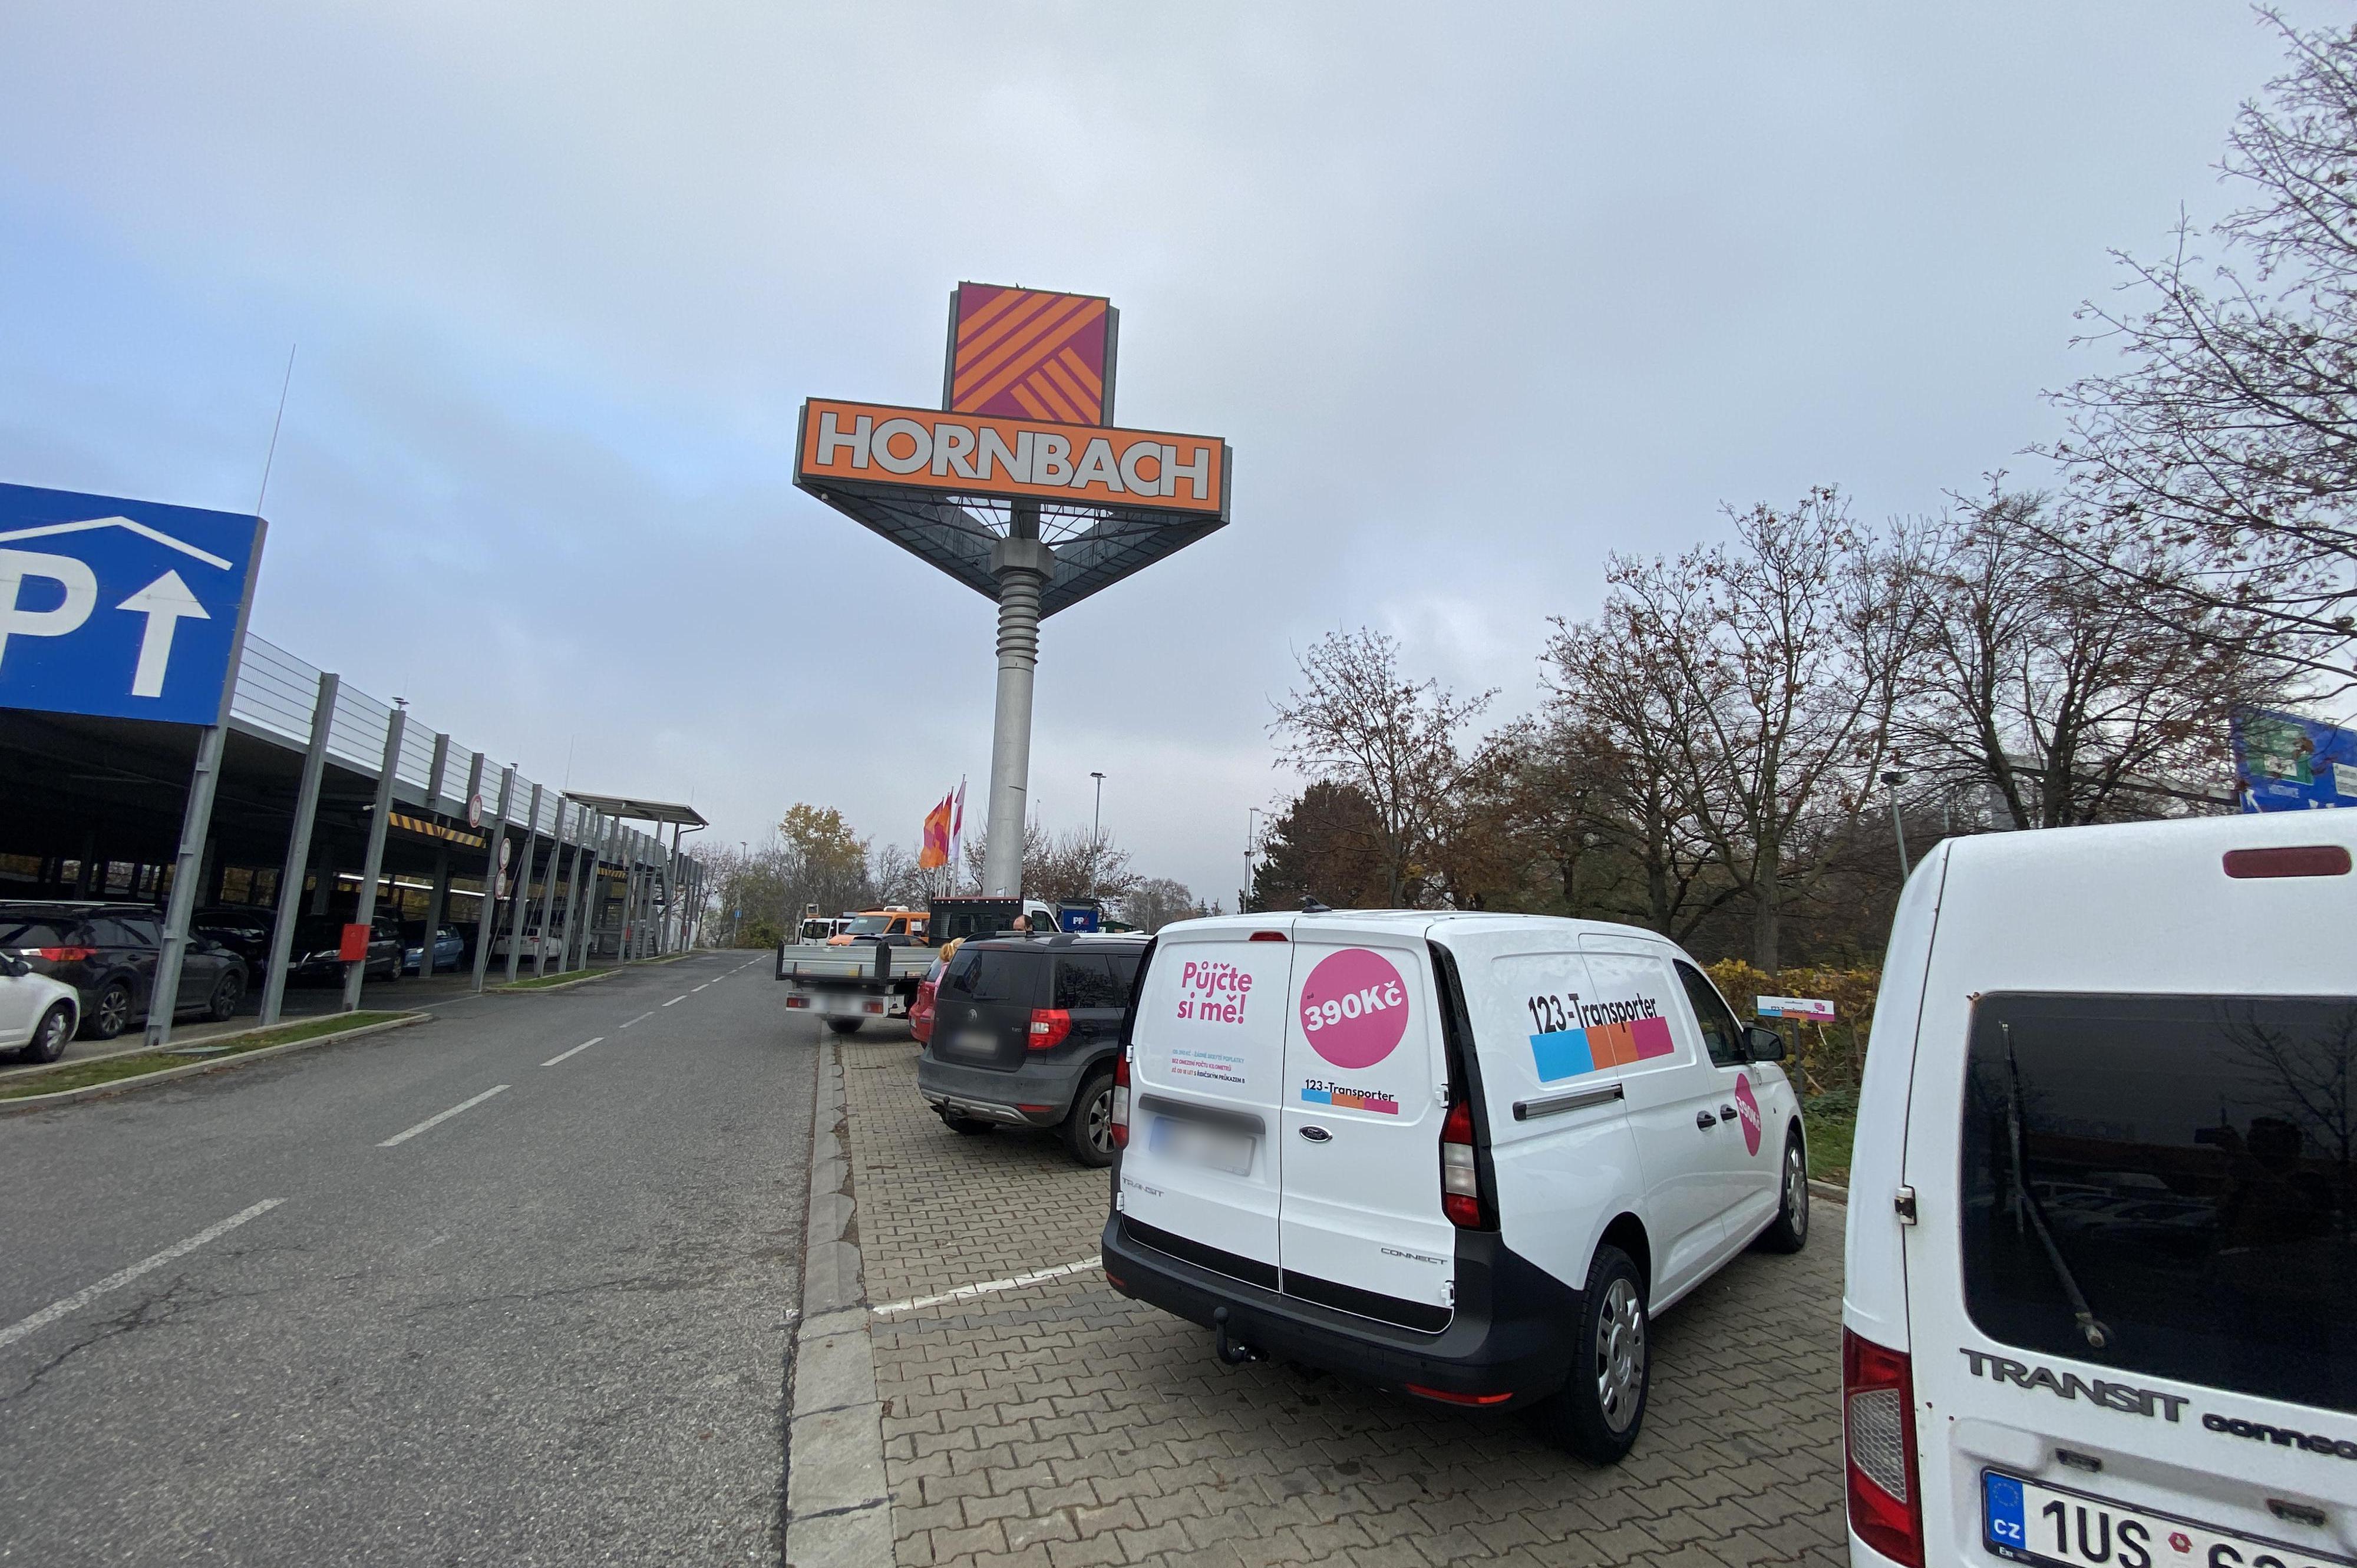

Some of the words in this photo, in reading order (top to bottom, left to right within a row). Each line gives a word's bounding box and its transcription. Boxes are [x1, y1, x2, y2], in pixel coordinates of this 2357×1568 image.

[816, 410, 1211, 500] HORNBACH
[0, 549, 98, 671] P
[1181, 961, 1252, 998] Půjčte
[1177, 992, 1195, 1018] si
[1200, 994, 1246, 1024] mě!
[1305, 981, 1402, 1031] 390Kč
[1219, 1074, 1242, 1083] PRŮKAZEM
[1306, 1079, 1394, 1101] 123-Transporter
[1381, 1247, 1447, 1265] CONNECT
[1959, 1347, 2190, 1422] TRANSIT
[1994, 1519, 2020, 1539] CZ
[2043, 1500, 2151, 1568] 1US
